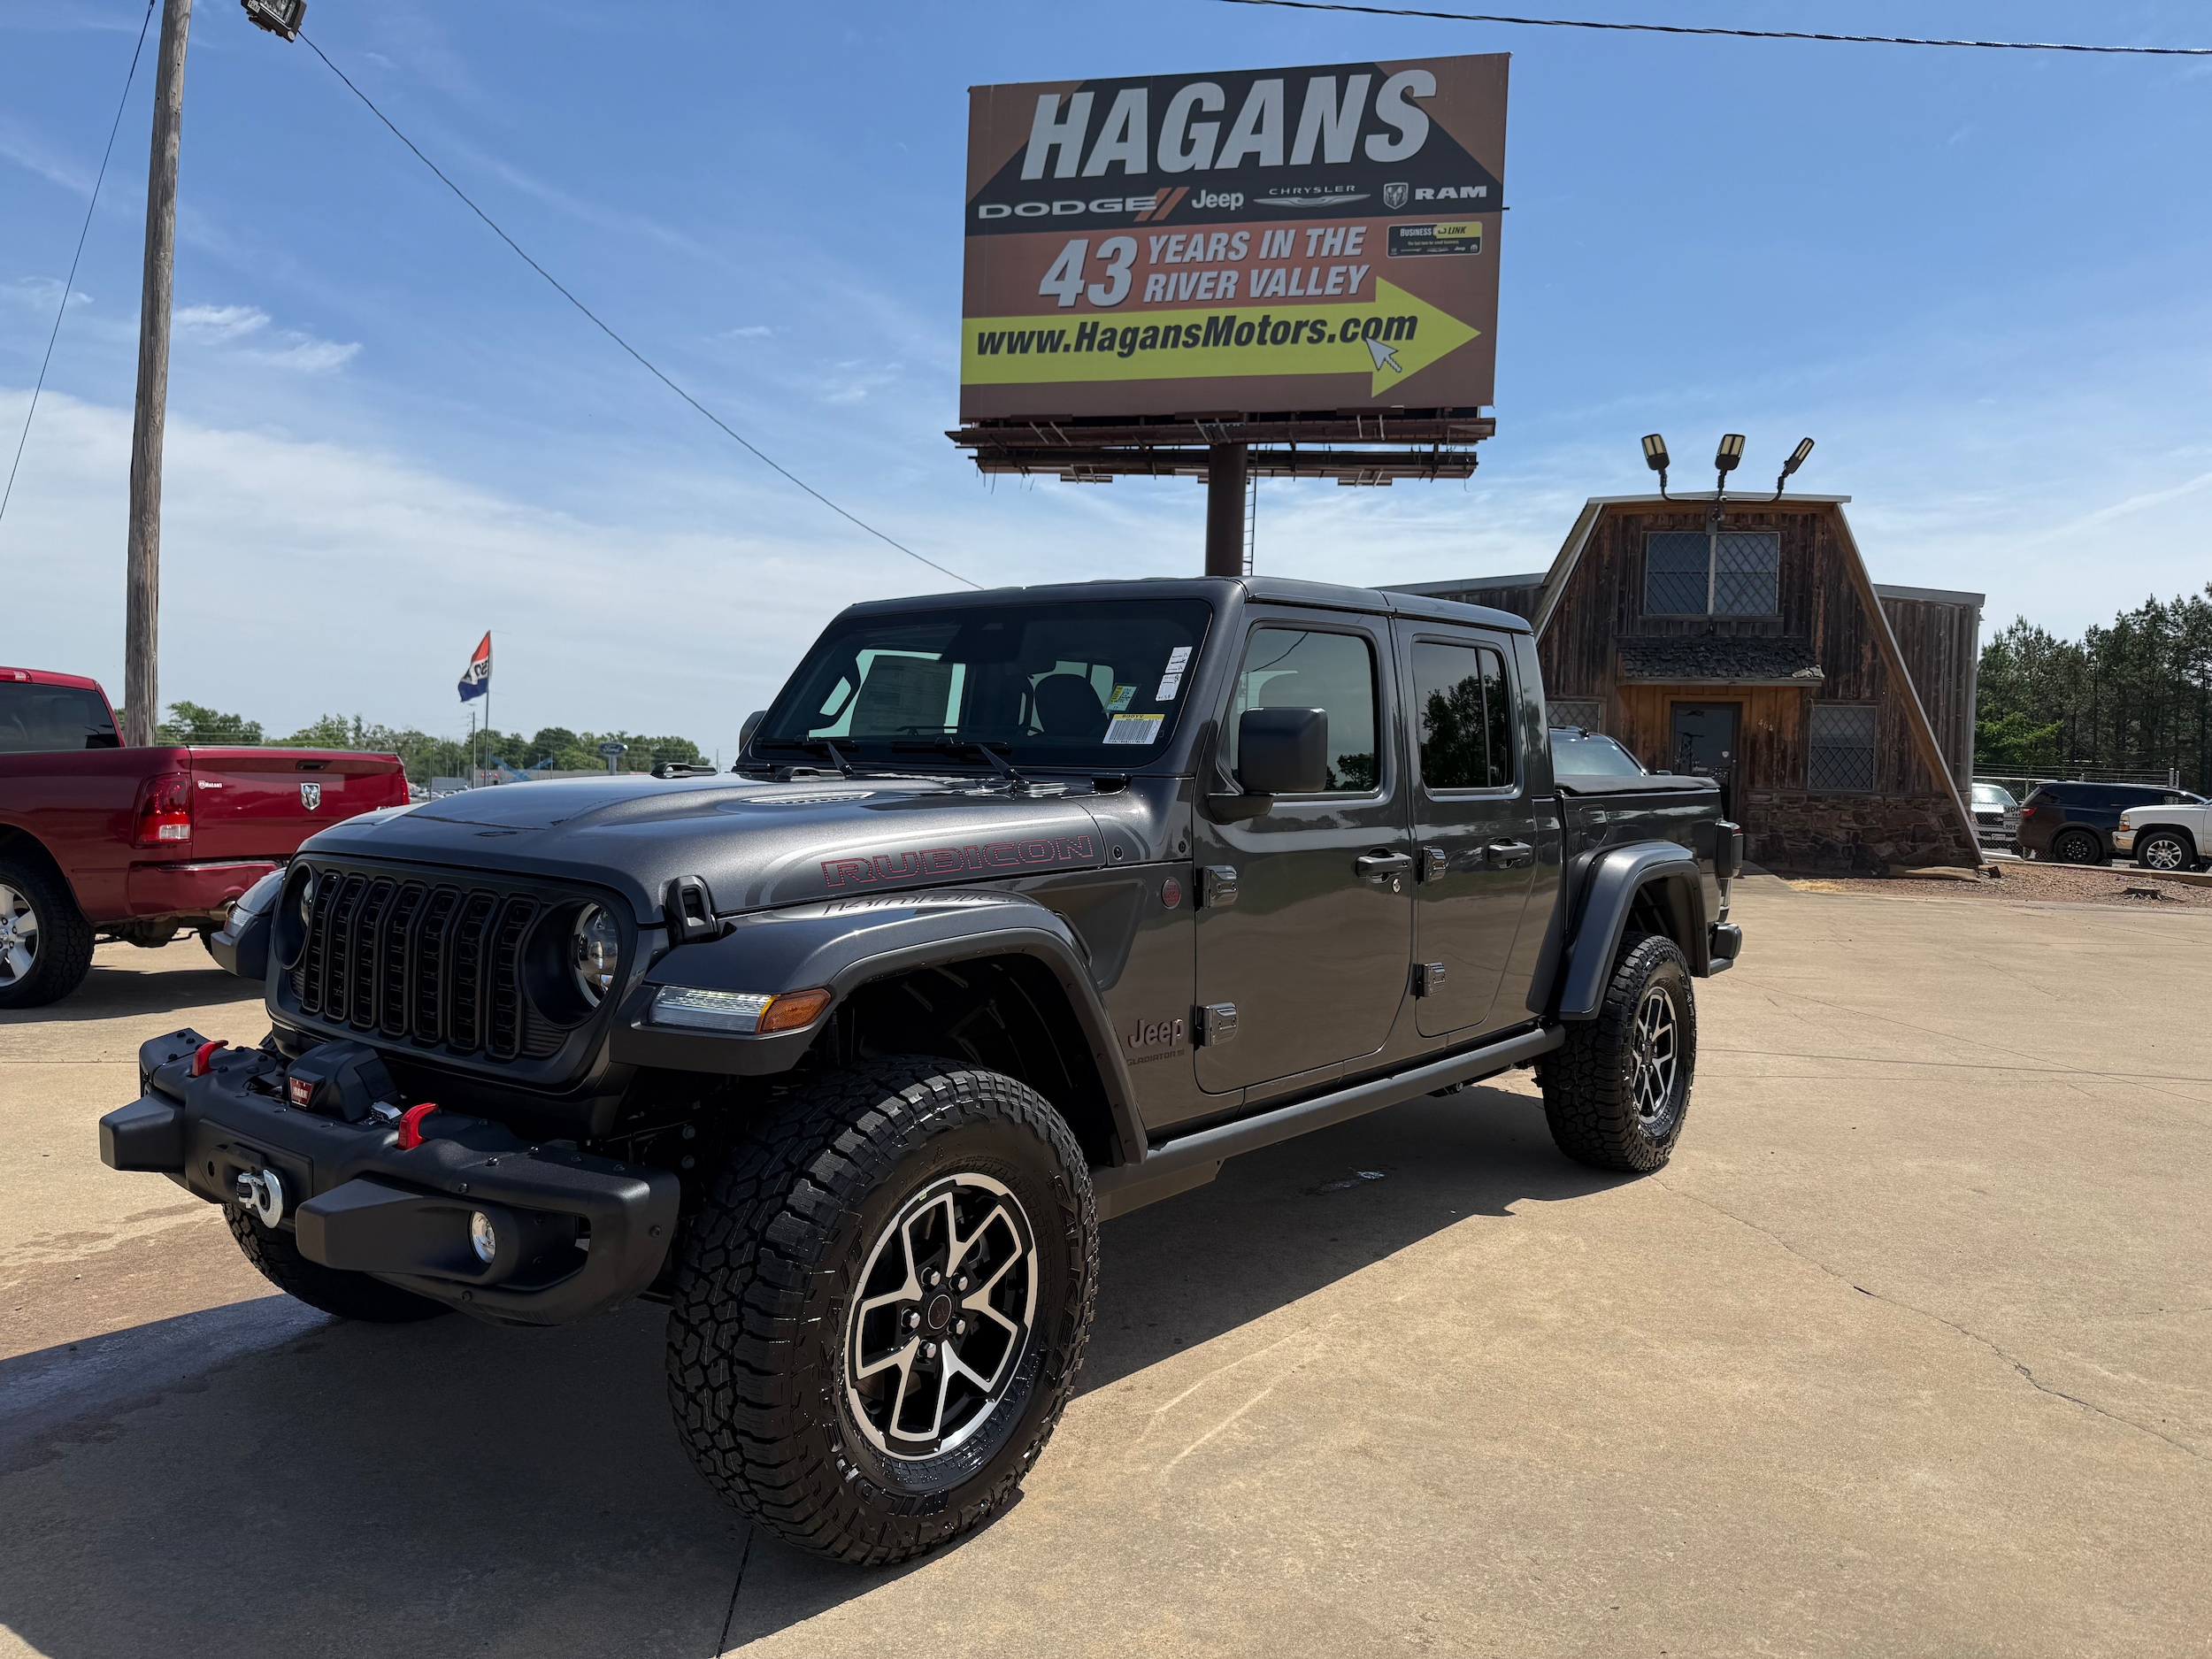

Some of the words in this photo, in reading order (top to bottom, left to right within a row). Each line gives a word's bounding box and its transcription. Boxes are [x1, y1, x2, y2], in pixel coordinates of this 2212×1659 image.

[1020, 69, 1436, 180] HAGANS
[979, 196, 1157, 219] DODGE
[1192, 180, 1244, 211] Jeep
[1269, 185, 1356, 196] CHRYSLER
[1415, 186, 1487, 200] RAM
[1148, 231, 1250, 265] YEARS
[1259, 229, 1296, 260] IN
[1305, 227, 1367, 258] THE
[1039, 235, 1139, 308] 43
[1143, 270, 1240, 303] RIVER
[1249, 265, 1371, 299] VALLEY
[978, 314, 1417, 358] www.HagansMotors.com
[821, 835, 1094, 887] RUBICON
[1128, 1018, 1185, 1048] Jeep
[1126, 1050, 1176, 1066] GLADIATOR
